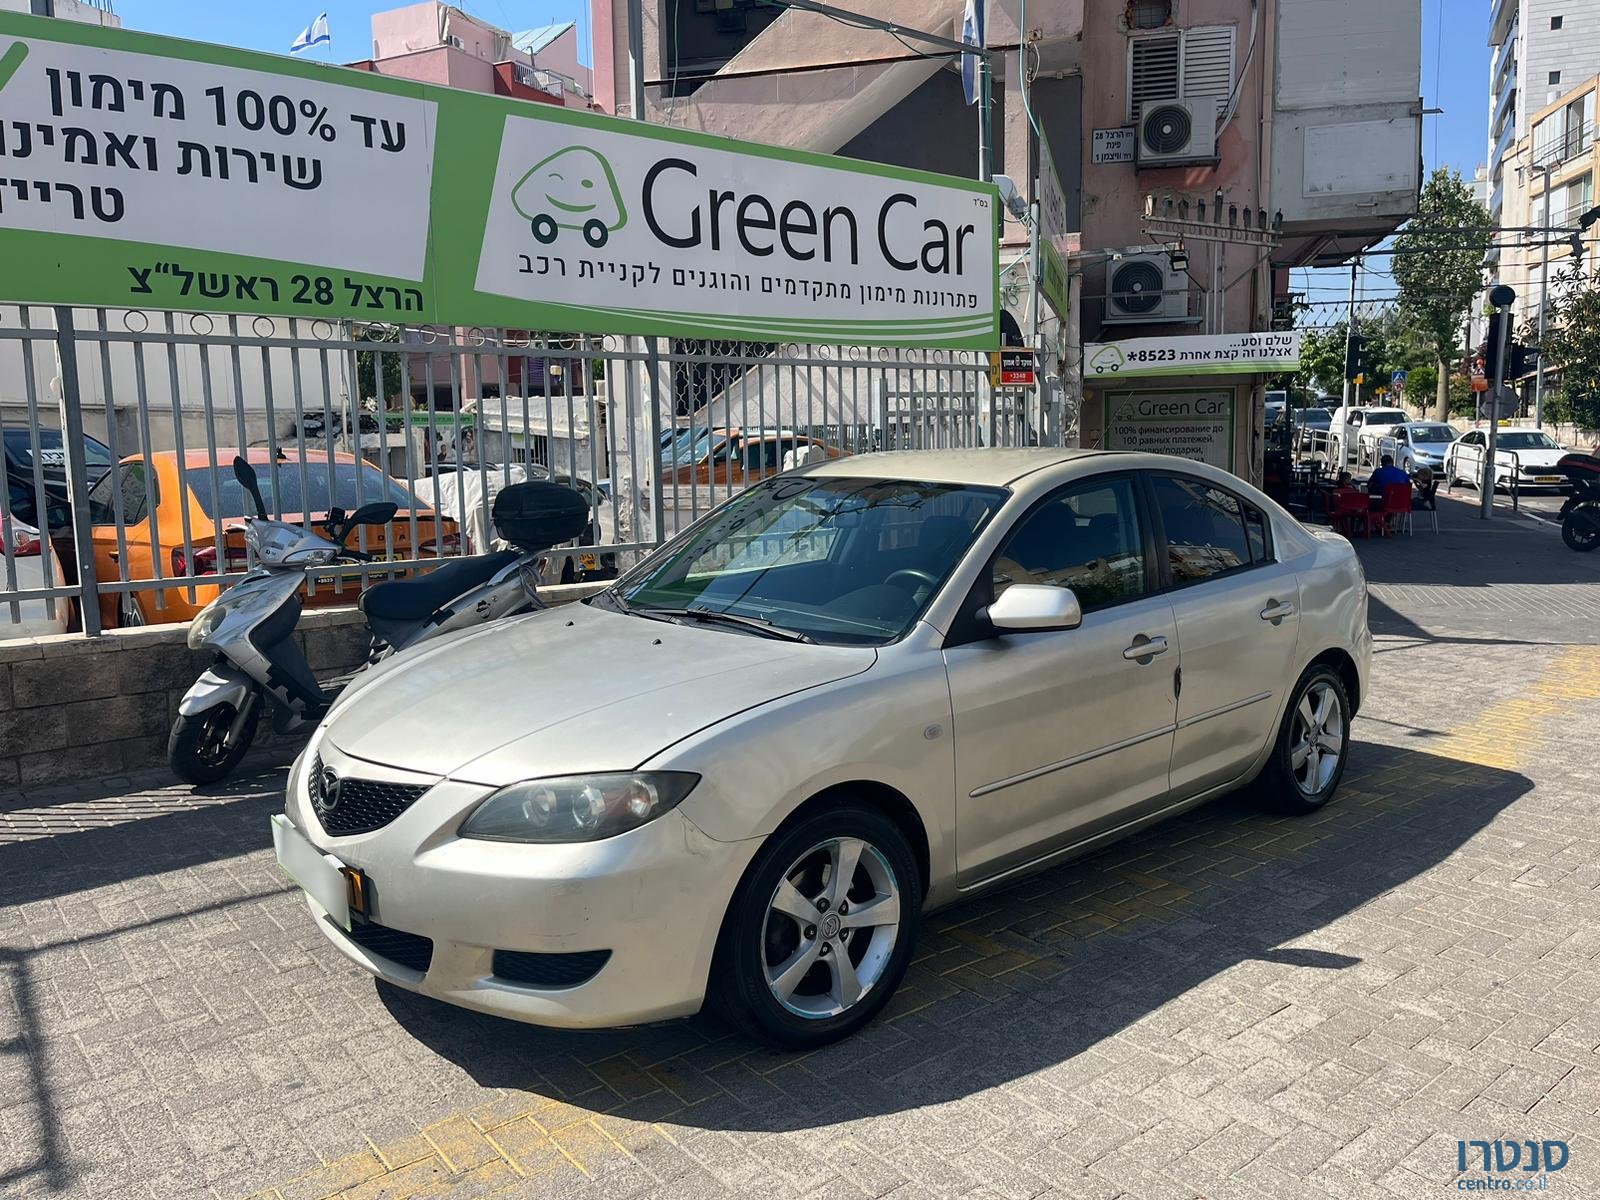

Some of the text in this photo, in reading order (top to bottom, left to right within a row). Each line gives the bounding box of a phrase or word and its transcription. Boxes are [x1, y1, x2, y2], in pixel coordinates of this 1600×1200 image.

[46, 68, 406, 152] עד 100% מימון
[1105, 131, 1124, 139] הרצל
[1105, 141, 1121, 150] פינת
[177, 141, 322, 190] שירות
[642, 158, 859, 266] Green
[878, 194, 975, 276] Car
[518, 253, 977, 309] פתרונות מימון מתקדמים והוגנים לקניית רכב
[291, 275, 335, 305] 28
[344, 278, 424, 312] הרצל
[1266, 336, 1292, 346] שלם
[1179, 351, 1211, 361] אחרת
[1214, 350, 1239, 361] קצת
[1242, 349, 1256, 358] זה
[1259, 347, 1292, 358] אצלנו
[1138, 398, 1225, 416] Green Car
[1114, 424, 1224, 436] 100% финансирование до
[1122, 436, 1138, 445] 100
[1139, 437, 1170, 446] равных
